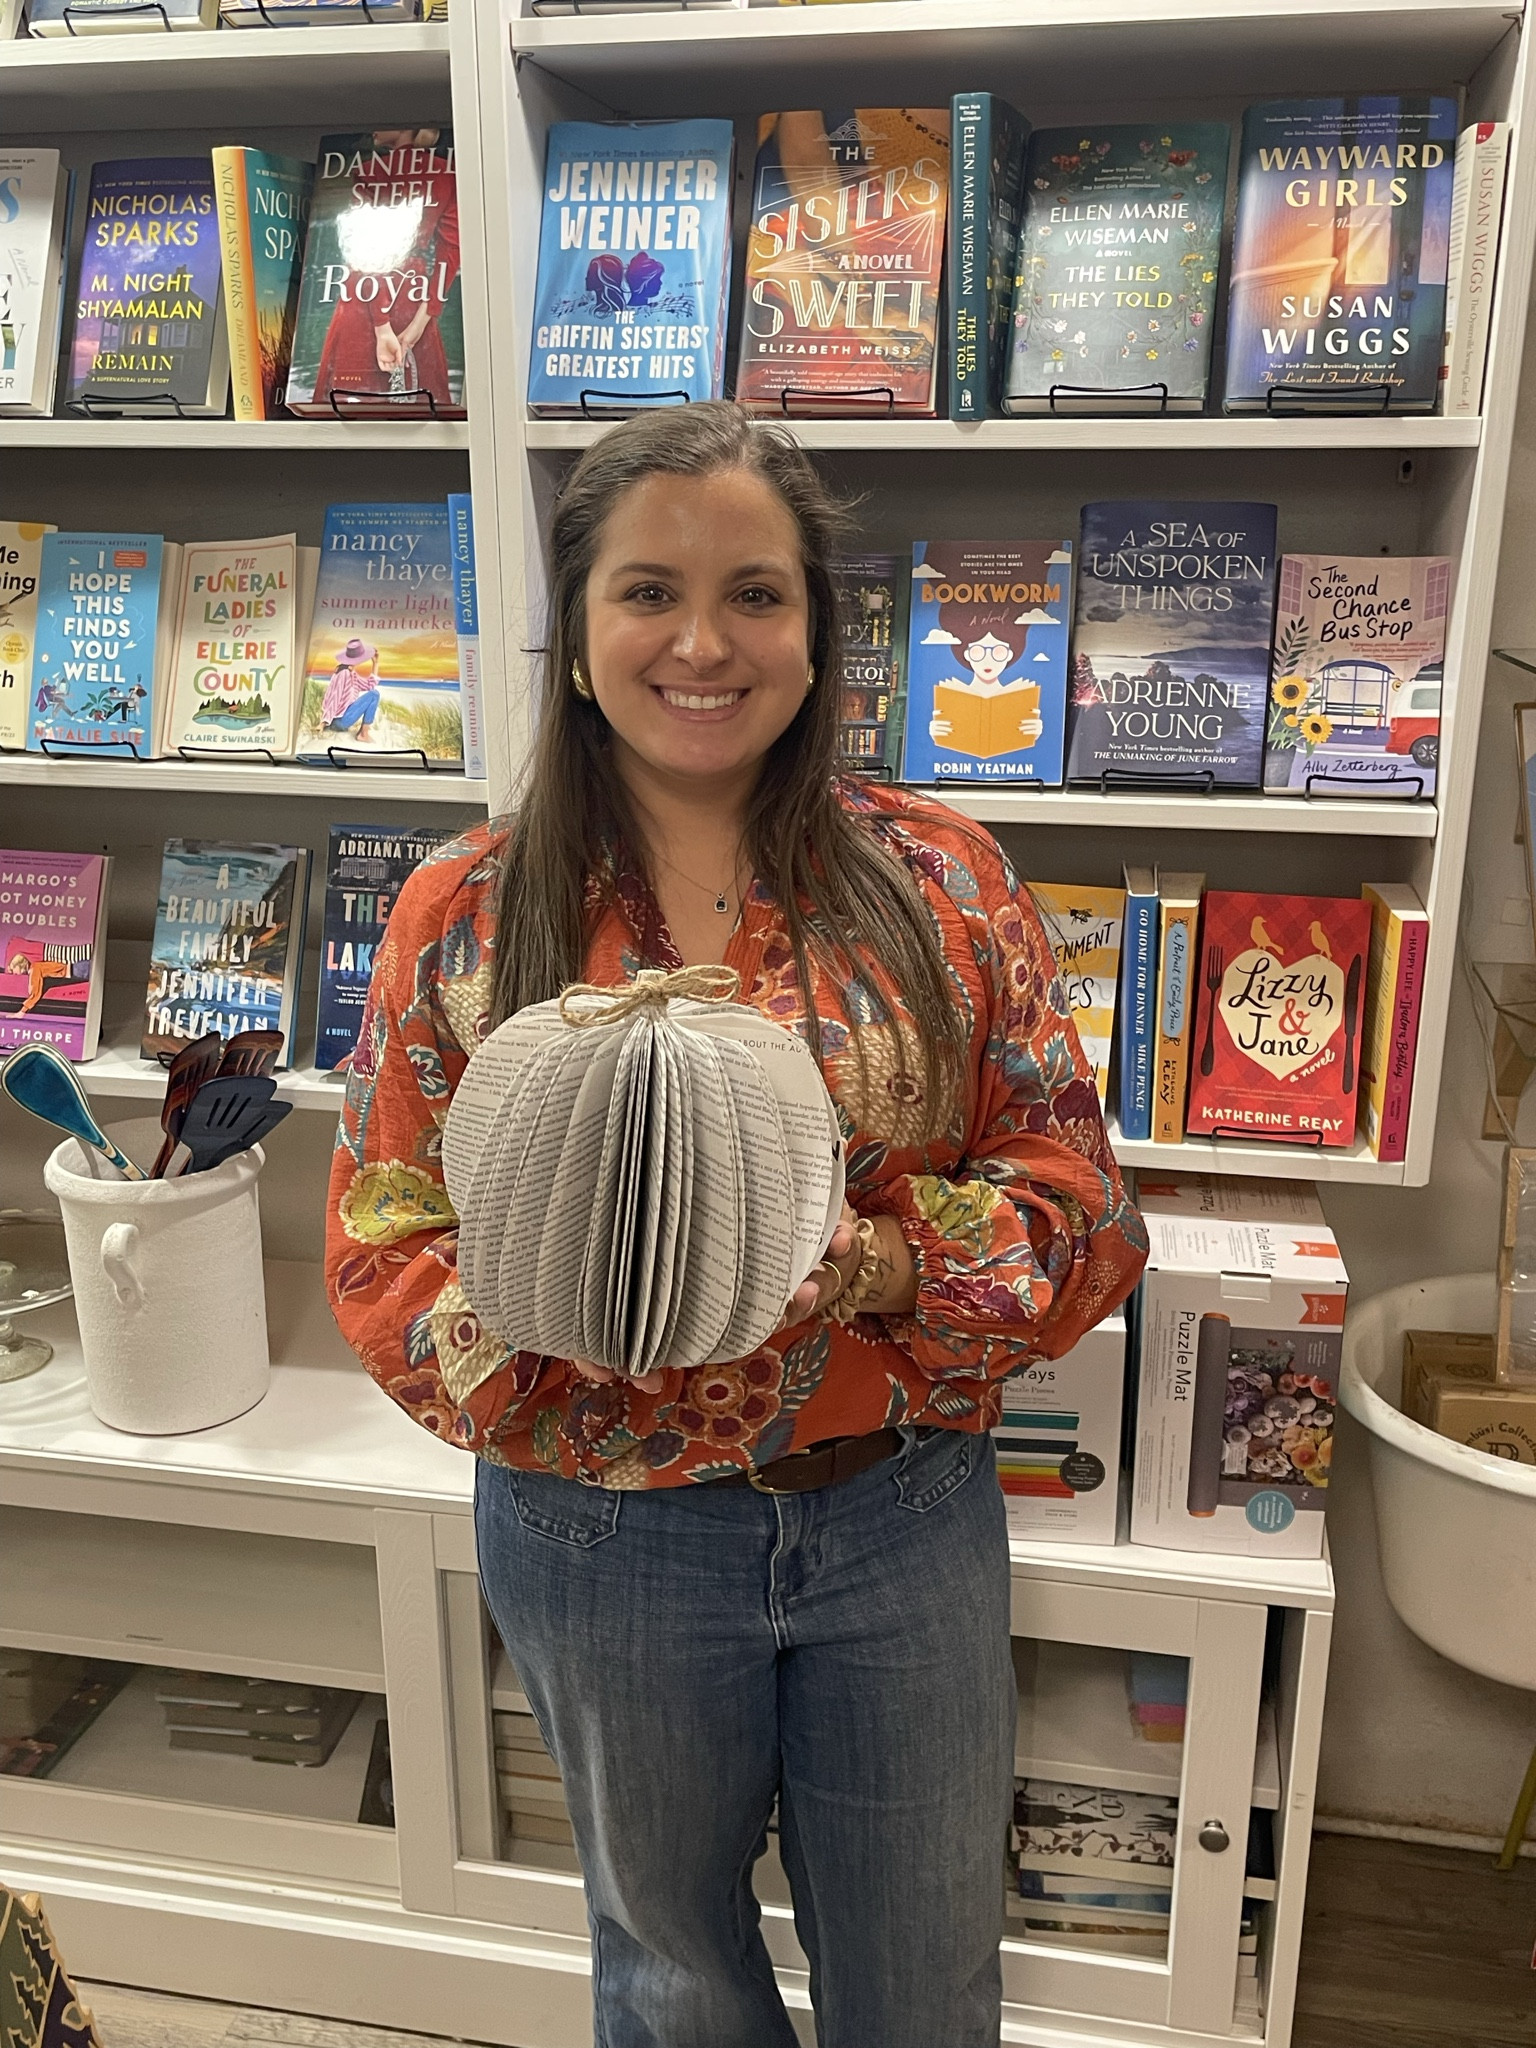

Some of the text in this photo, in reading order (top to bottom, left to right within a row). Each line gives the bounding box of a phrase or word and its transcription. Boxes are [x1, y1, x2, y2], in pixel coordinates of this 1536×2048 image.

[829, 147, 875, 160] THE
[963, 126, 975, 170] ELLEN
[1259, 144, 1443, 171] WAYWARD
[549, 160, 717, 202] JENNIFER
[1285, 178, 1407, 207] GIRLS
[91, 195, 211, 217] NICHOLAS
[351, 181, 438, 209] STEEL
[963, 174, 975, 222] MARIE
[1477, 168, 1495, 227] SUSAN
[755, 158, 940, 258] SISTERS
[1050, 203, 1189, 223] ELLEN MARIE
[96, 221, 198, 247] SPARKS
[560, 206, 700, 250] WEINER
[1065, 228, 1169, 246] WISEMAN
[838, 255, 913, 269] A NOVEL
[962, 226, 975, 295] WISEMAN
[1095, 249, 1103, 257] A
[1470, 233, 1488, 294] WIGGS
[91, 274, 193, 292] M. NIGHT
[221, 164, 248, 386] NICHOLAS SPARKS DREAMLAND
[685, 279, 705, 288] novel
[1065, 266, 1161, 282] THE LIES
[319, 262, 449, 313] Royal
[1048, 291, 1172, 308] THEY TOLD
[77, 300, 202, 319] SHYAMALAN
[615, 311, 634, 324] THE
[747, 279, 931, 338] SWEET
[1281, 296, 1393, 318] SUSAN
[537, 326, 613, 349] GRIFFIN
[759, 344, 911, 355] ELIZABETH WEISS
[956, 308, 967, 381] THEY TOLD
[967, 316, 977, 372] THE LIES
[1262, 328, 1410, 355] WIGGS
[92, 355, 173, 371] REMAIN
[546, 354, 695, 378] GREATEST HITS
[1259, 372, 1405, 387] The Lost and Found Bookshop
[330, 532, 423, 561] nancy
[1120, 522, 1246, 548] A SEA OF
[98, 551, 105, 569] I
[234, 558, 257, 570] THE
[454, 509, 476, 627] nancy thayer
[1092, 553, 1266, 581] UNSPOKEN
[69, 573, 132, 593] HOPE
[193, 567, 288, 598] FUNERAL
[1321, 565, 1348, 584] The
[921, 583, 1061, 604] BOOKWORM
[1113, 584, 1233, 612] THINGS
[1308, 575, 1379, 599] Second
[72, 596, 124, 616] THIS
[204, 599, 277, 625] LADIES
[321, 595, 450, 614] summer light
[1333, 598, 1412, 620] Chance
[63, 617, 130, 638] FINDS
[232, 624, 252, 638] OF
[332, 614, 457, 630] on nantucke
[1320, 617, 1413, 643] Bus Stop
[71, 640, 119, 660] YOU
[196, 641, 277, 665] ELLERIE
[63, 662, 126, 683] WELL
[193, 665, 285, 696] COUNTY
[464, 649, 478, 748] family reunion
[1088, 679, 1250, 709] ADRIENNE
[34, 725, 102, 742] NATALIE
[110, 729, 142, 746] SUE
[1106, 711, 1224, 740] YOUNG
[183, 733, 276, 744] CLAIRE SWINARSKI
[933, 762, 1033, 775] ROBIN YEATMAN
[1113, 753, 1163, 761] UNMAKING
[1177, 755, 1201, 763] JUNE
[1202, 756, 1239, 764] FARROW
[1302, 759, 1402, 779] Ally Zetterberg
[338, 840, 401, 859] ADRIANA
[2, 872, 77, 887] MARGO'S
[216, 863, 230, 890] A
[28, 894, 87, 908] MONEY
[165, 894, 277, 929] BEAUTIFUL
[343, 893, 390, 924] THE
[0, 912, 77, 928] ROUBLES
[178, 930, 254, 963] FAMILY
[1135, 908, 1149, 1036] GO HOME FOR DINNER
[1404, 938, 1417, 991] HAPPY LIFE
[155, 970, 267, 1006] JENNIFER
[1228, 957, 1333, 1016] Lizzy
[1278, 998, 1312, 1036] &
[12, 1029, 73, 1043] THORPE
[333, 1028, 352, 1037] NOVEL
[1238, 1011, 1319, 1057] Jane
[771, 1043, 785, 1051] THE
[1135, 1042, 1147, 1112] MIKE PENCE
[1289, 1048, 1336, 1083] a novel
[1160, 1059, 1170, 1105] REAY
[1202, 1106, 1344, 1131] KATHERINE REAY
[1254, 1227, 1277, 1269] Puzzle Mat
[1174, 1311, 1196, 1402] Puzzle Mat
[1004, 1385, 1029, 1393] Puzzle
